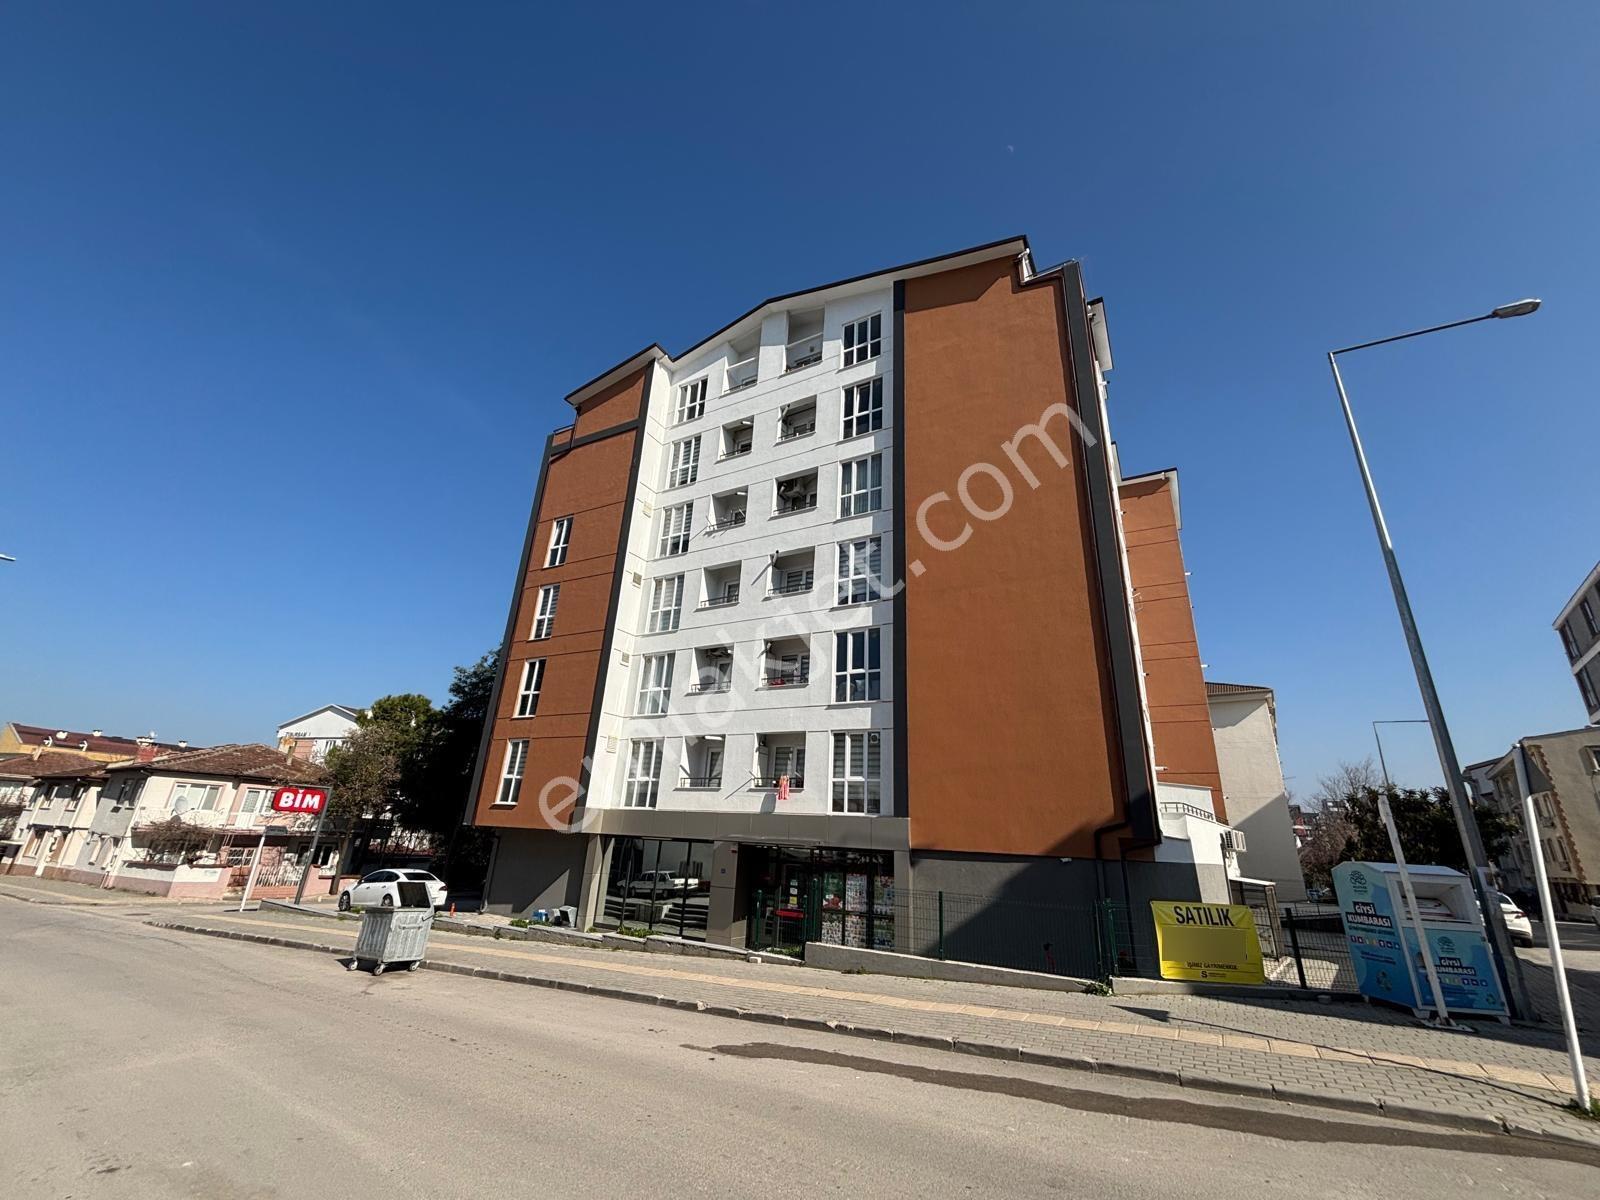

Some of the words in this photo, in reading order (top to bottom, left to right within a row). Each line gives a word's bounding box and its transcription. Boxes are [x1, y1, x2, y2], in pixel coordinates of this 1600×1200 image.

[278, 789, 321, 809] BİM
[1174, 905, 1235, 927] SATILIK
[1347, 914, 1391, 927] KUMBARASI
